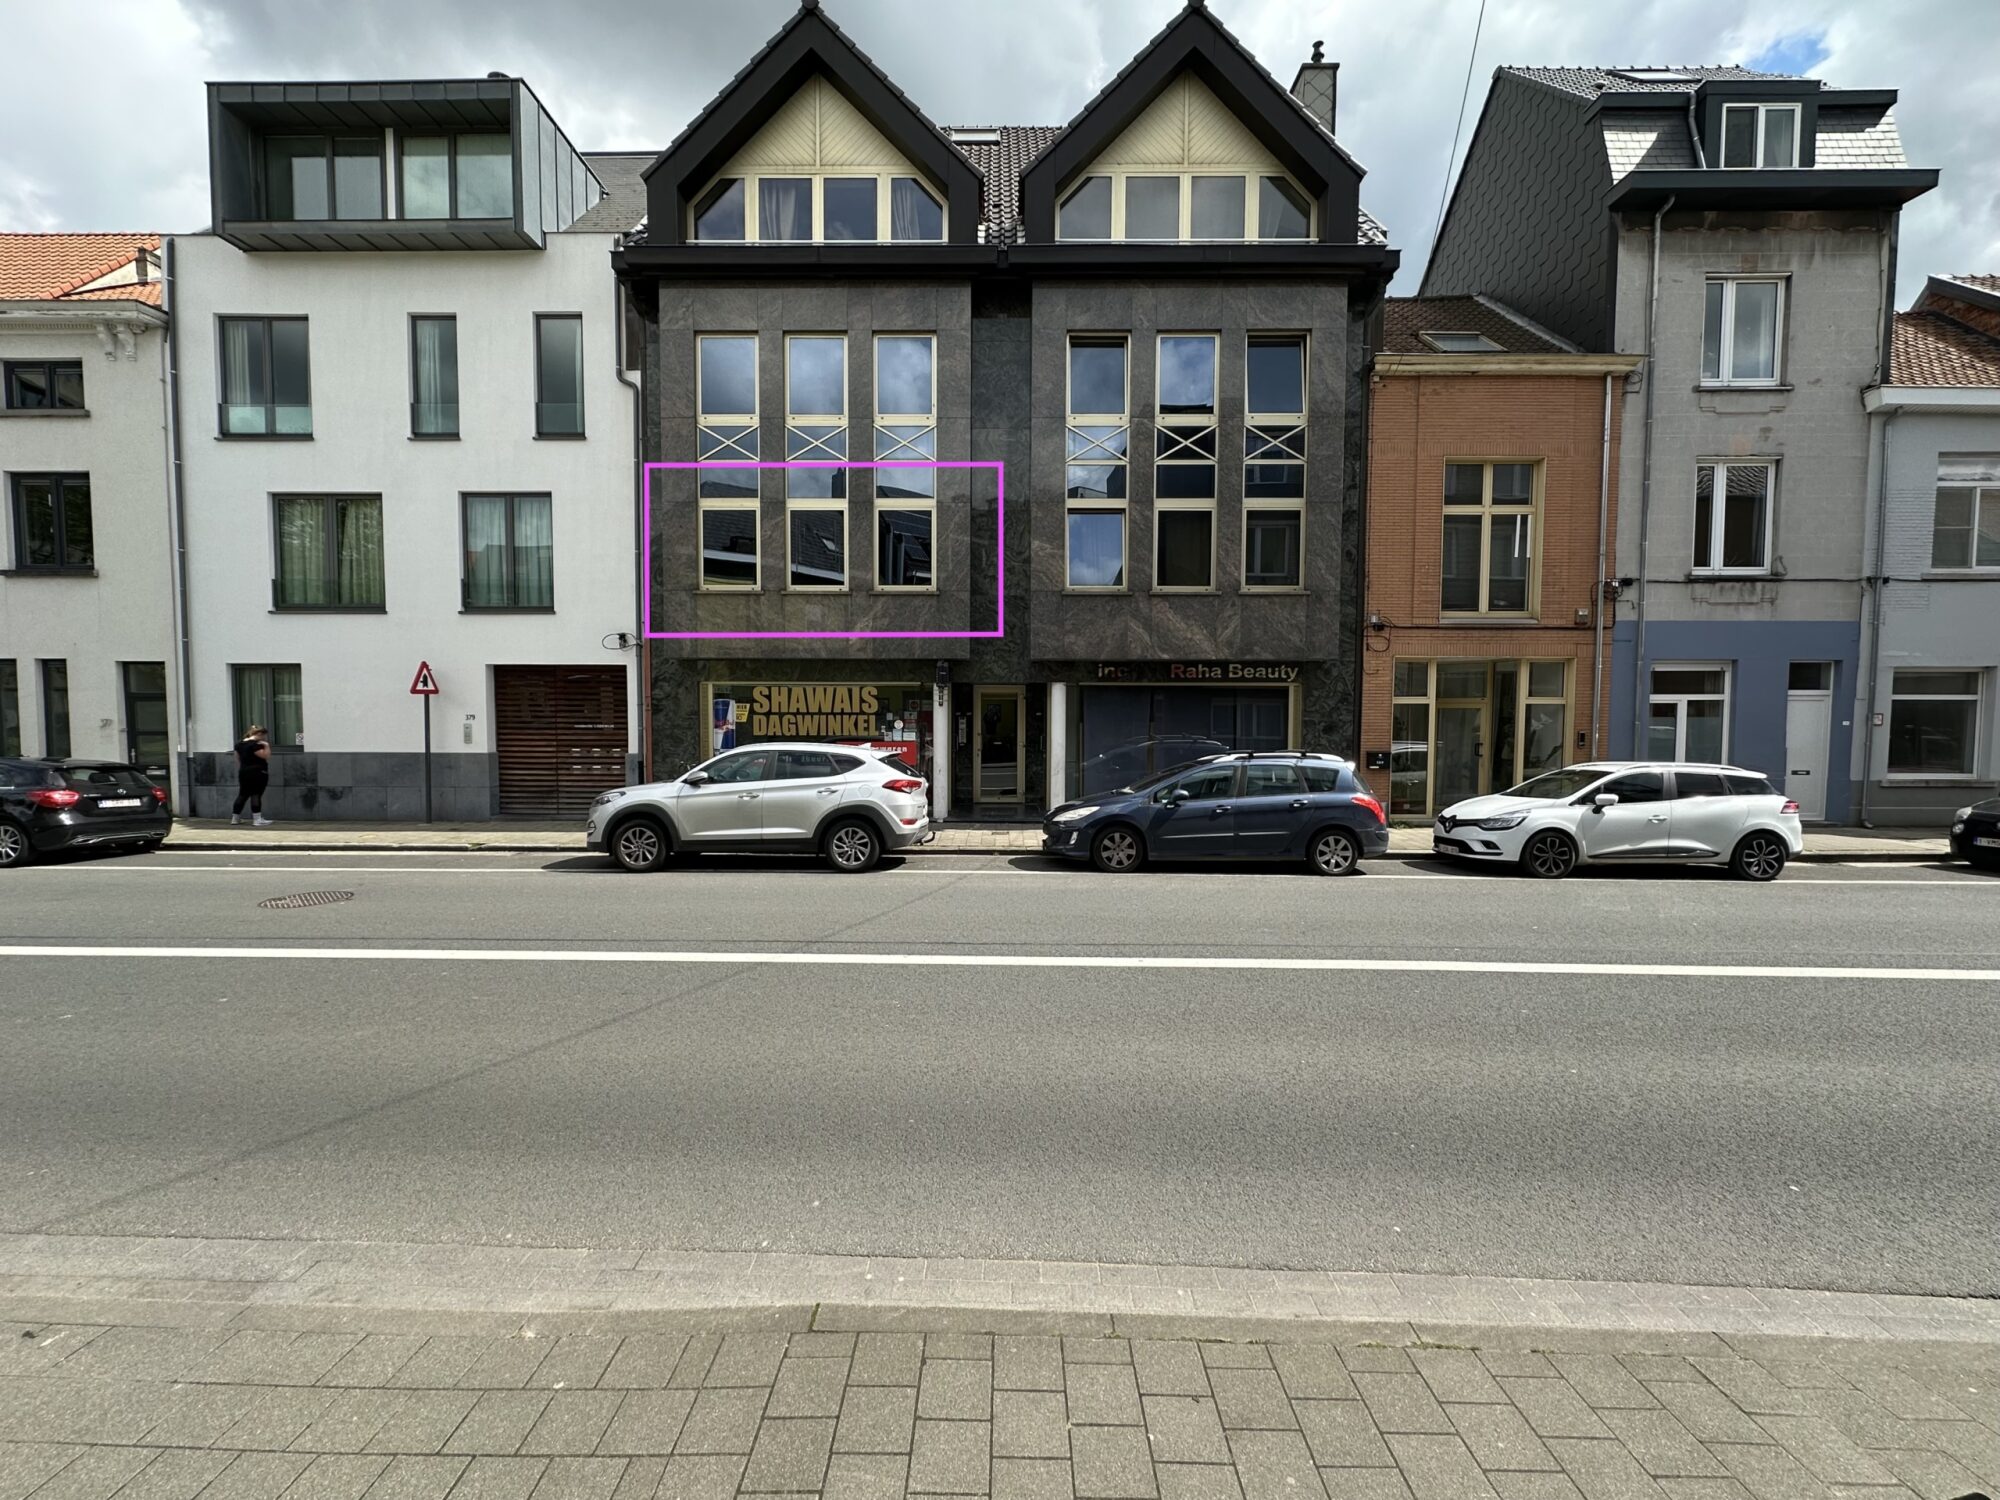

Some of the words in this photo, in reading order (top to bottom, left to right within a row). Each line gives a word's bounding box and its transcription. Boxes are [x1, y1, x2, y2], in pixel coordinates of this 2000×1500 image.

[1170, 664, 1222, 679] Raha
[1228, 664, 1299, 682] Beauty
[752, 686, 879, 714] SHAWAIS
[753, 714, 879, 736] DAGWINKEL
